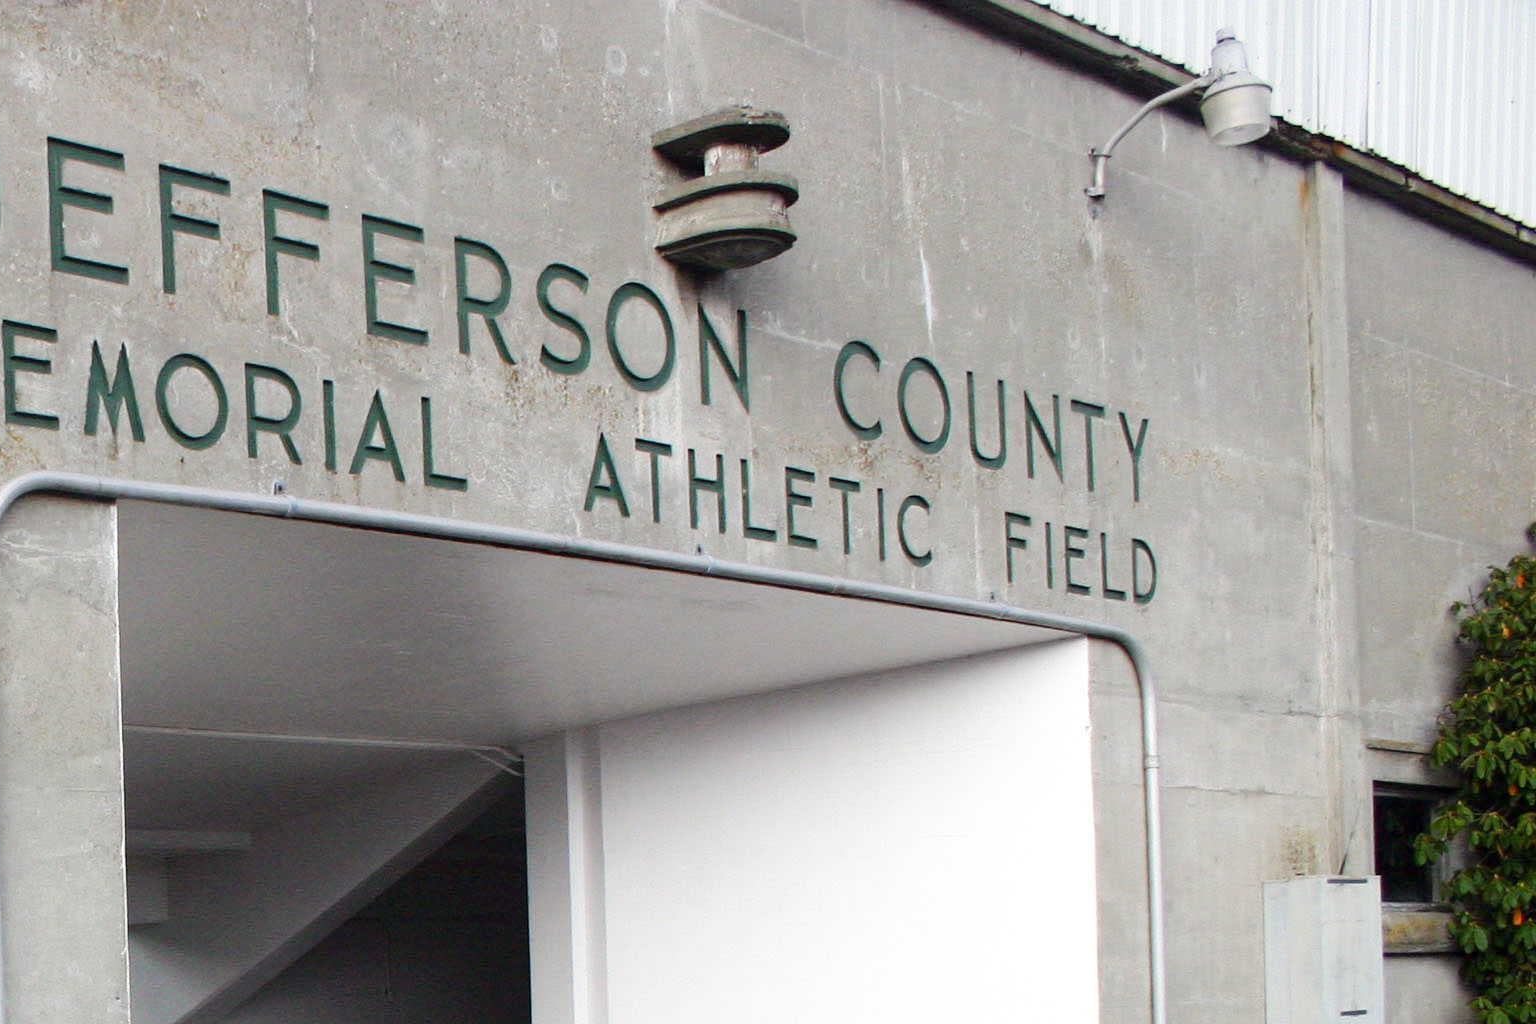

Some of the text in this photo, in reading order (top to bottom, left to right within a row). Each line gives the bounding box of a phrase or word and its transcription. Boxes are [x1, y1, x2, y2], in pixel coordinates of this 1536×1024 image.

[834, 339, 1150, 502] COUNTY
[584, 432, 932, 567] ATHLETIC
[1005, 511, 1158, 604] FIELD
